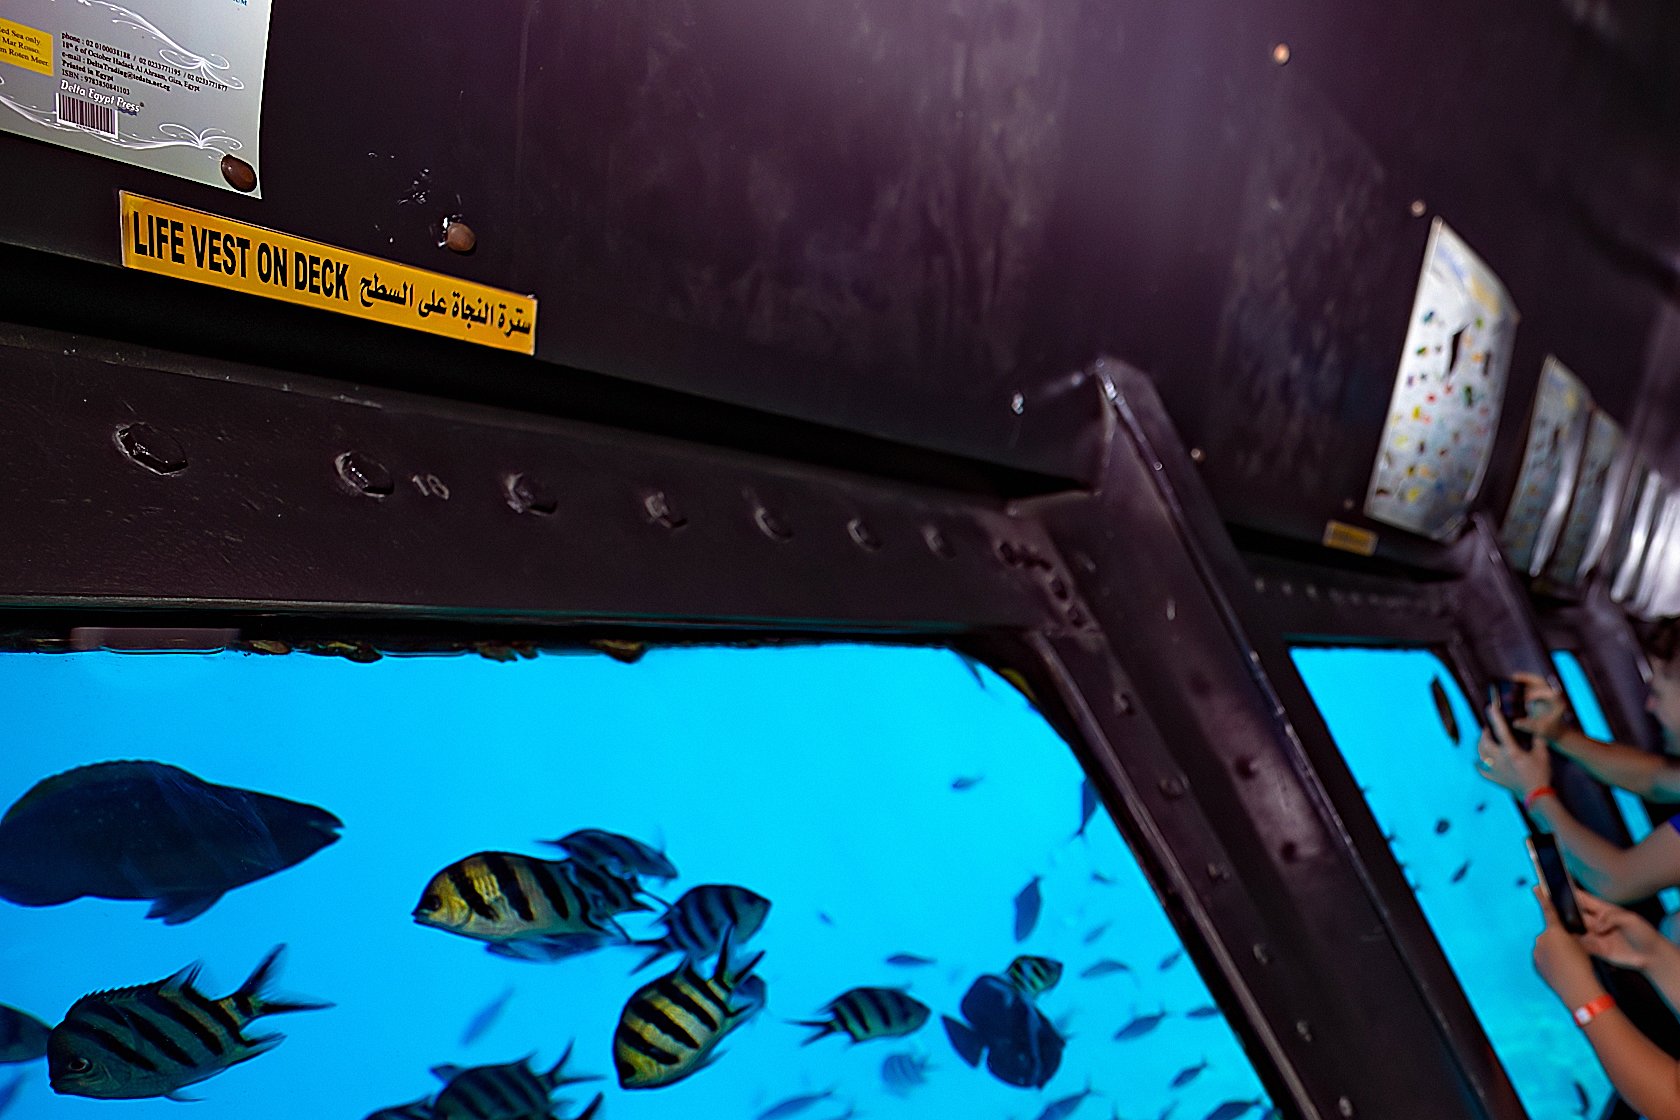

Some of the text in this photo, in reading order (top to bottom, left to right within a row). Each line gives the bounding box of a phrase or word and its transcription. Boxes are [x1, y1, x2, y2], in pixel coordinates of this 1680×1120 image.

[2, 36, 17, 47] Mar
[11, 30, 24, 40] Sea
[25, 36, 41, 46] only
[9, 48, 30, 61] Roten
[61, 32, 81, 43] phone
[85, 39, 94, 48] 02
[138, 56, 147, 65] 02
[187, 73, 196, 81] 02
[61, 50, 82, 63] e-mail
[61, 59, 86, 73] Printed
[94, 70, 114, 82] Egypt
[61, 68, 79, 80] ISBN
[88, 50, 112, 63] October
[135, 65, 143, 73] Al
[183, 80, 201, 93] Egypt
[60, 79, 141, 113] Delta Egypt Press
[133, 210, 350, 302] LIFE VEST ON DECK
[359, 272, 531, 338] سترة النجاة على السطح
